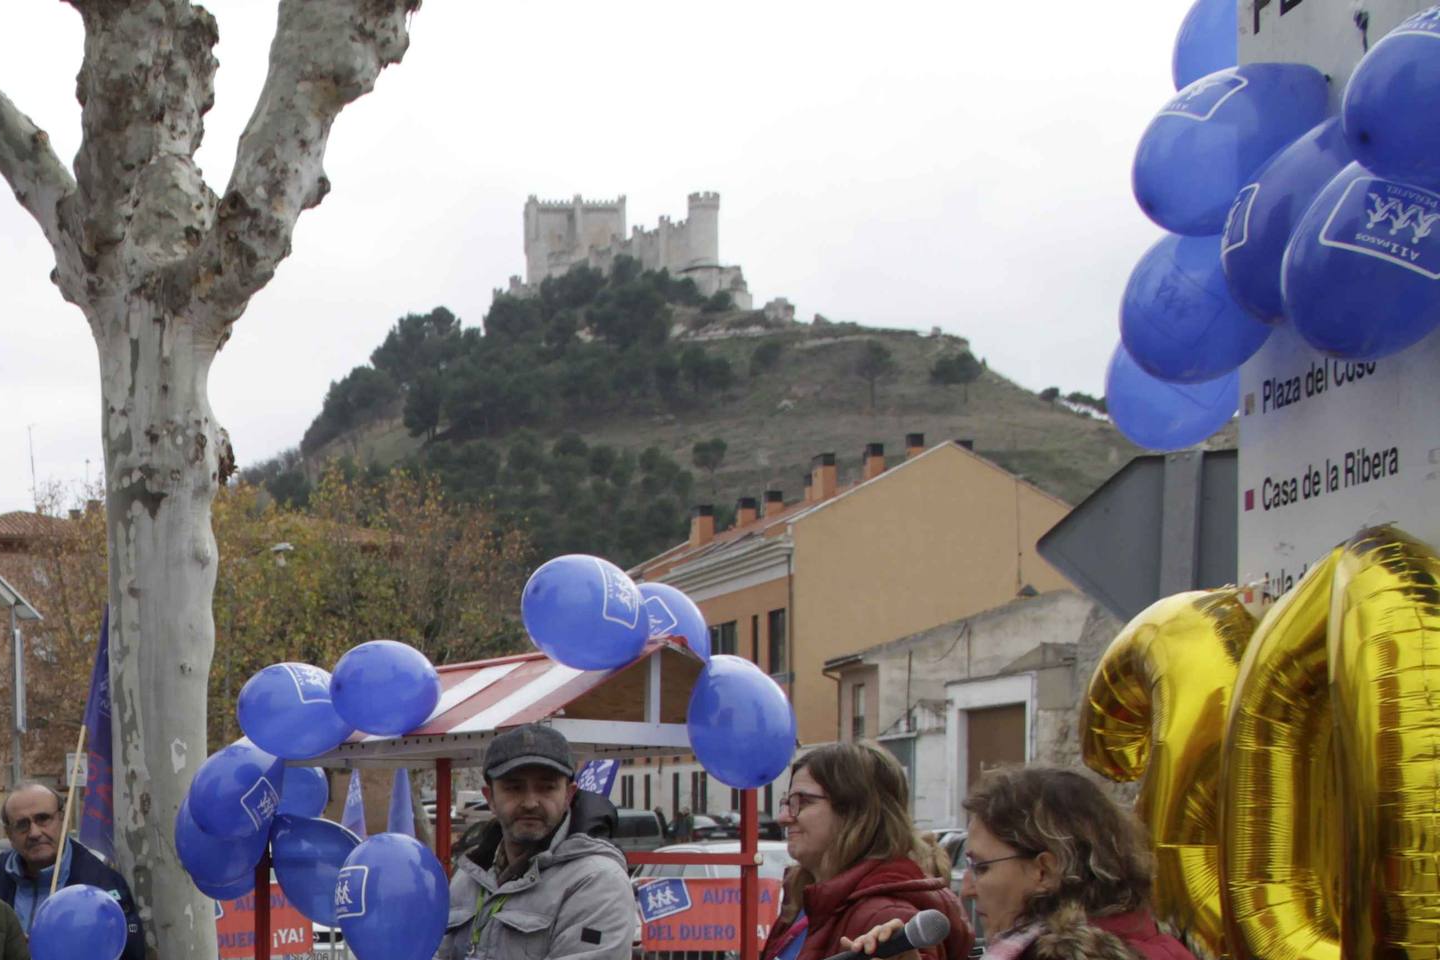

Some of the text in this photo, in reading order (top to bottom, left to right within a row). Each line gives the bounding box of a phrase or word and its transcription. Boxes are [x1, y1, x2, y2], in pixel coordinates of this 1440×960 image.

[1263, 375, 1301, 413] Plaza
[1305, 358, 1329, 397] del
[1262, 476, 1298, 511] Casa
[1303, 465, 1321, 499] de
[1326, 458, 1339, 493] la
[1344, 446, 1399, 488] Ribera
[273, 927, 304, 947] ¡YA!
[647, 924, 674, 941] DEL
[679, 924, 736, 941] DUERO
